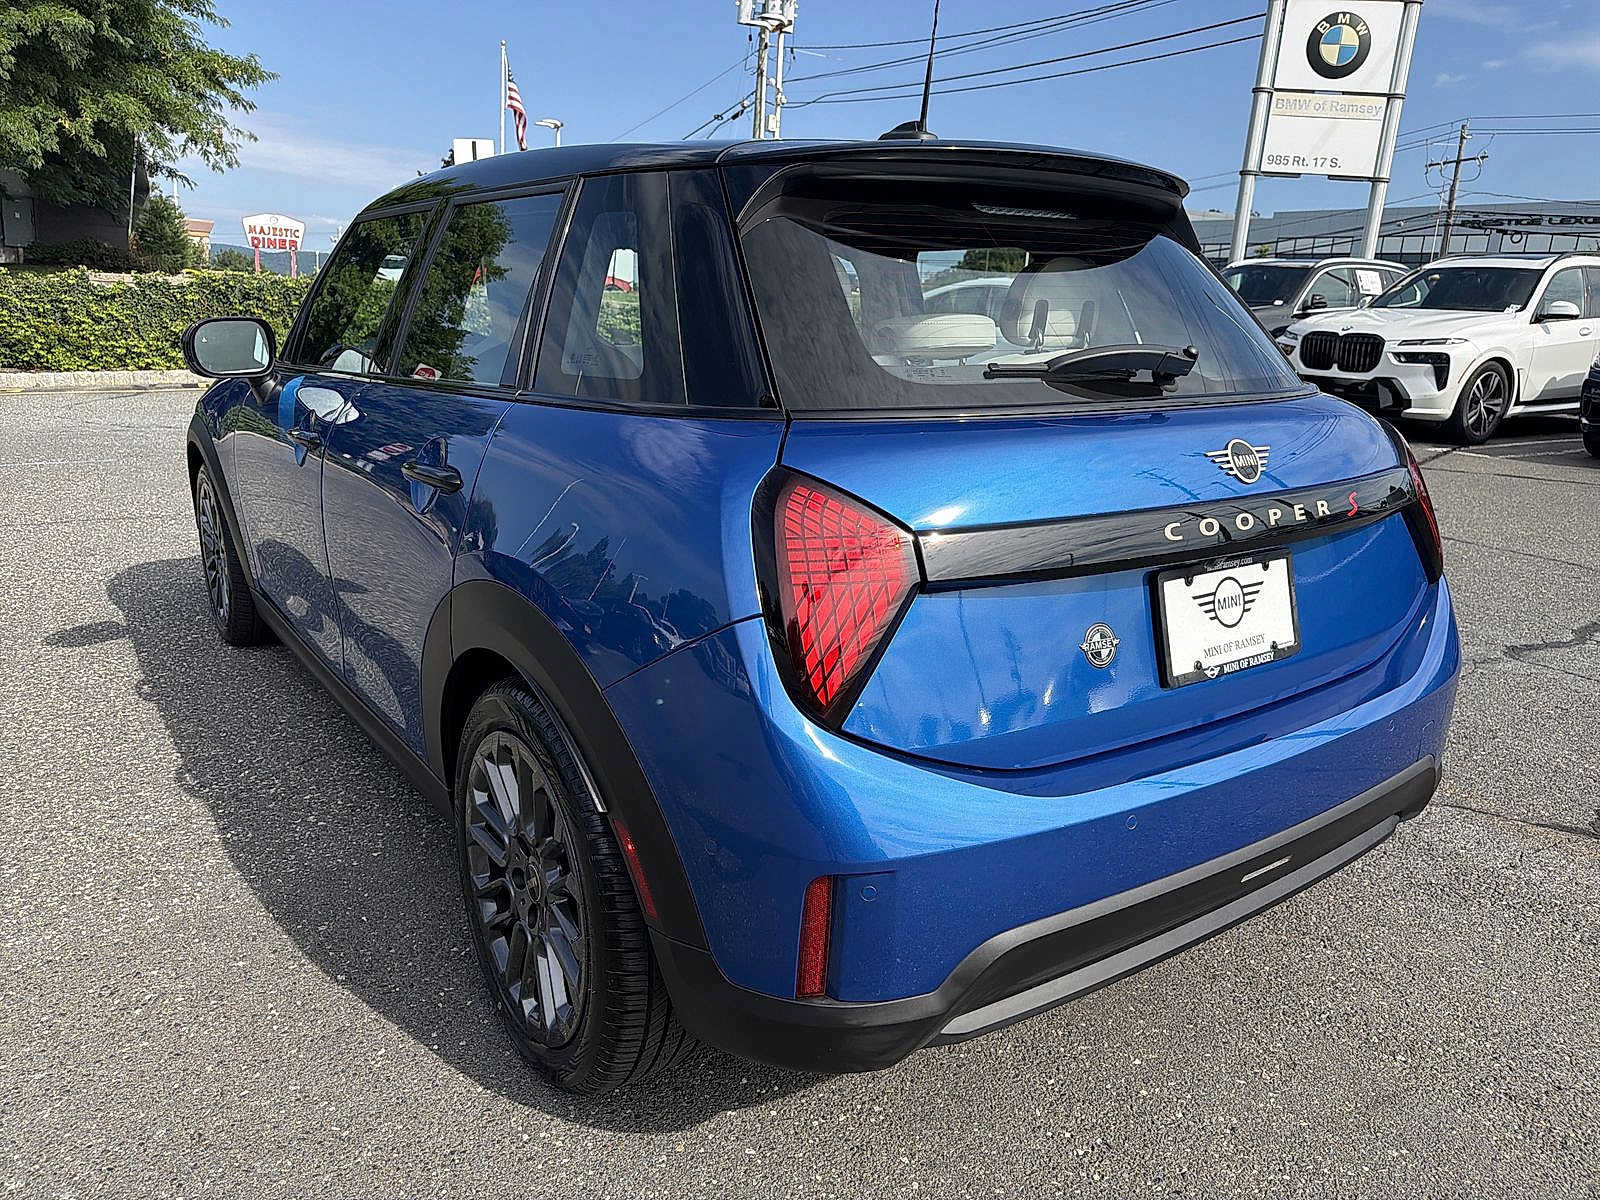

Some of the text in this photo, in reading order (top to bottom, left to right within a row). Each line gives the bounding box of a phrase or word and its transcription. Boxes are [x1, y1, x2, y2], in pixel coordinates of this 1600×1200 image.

[1316, 13, 1368, 36] BMW
[1275, 98, 1382, 116] BMW of Ramsey
[1266, 154, 1342, 169] 985 Rt. 17 S.
[248, 224, 300, 239] MAJESTIC
[251, 236, 298, 251] DINER
[1233, 454, 1258, 469] MINI
[1164, 491, 1359, 541] COOPER S
[1217, 594, 1241, 611] MINI
[1203, 645, 1222, 658] MINI
[1223, 641, 1234, 653] OF
[1235, 633, 1265, 650] RAMSEY
[1222, 651, 1275, 674] MINI OF RAMSEY
